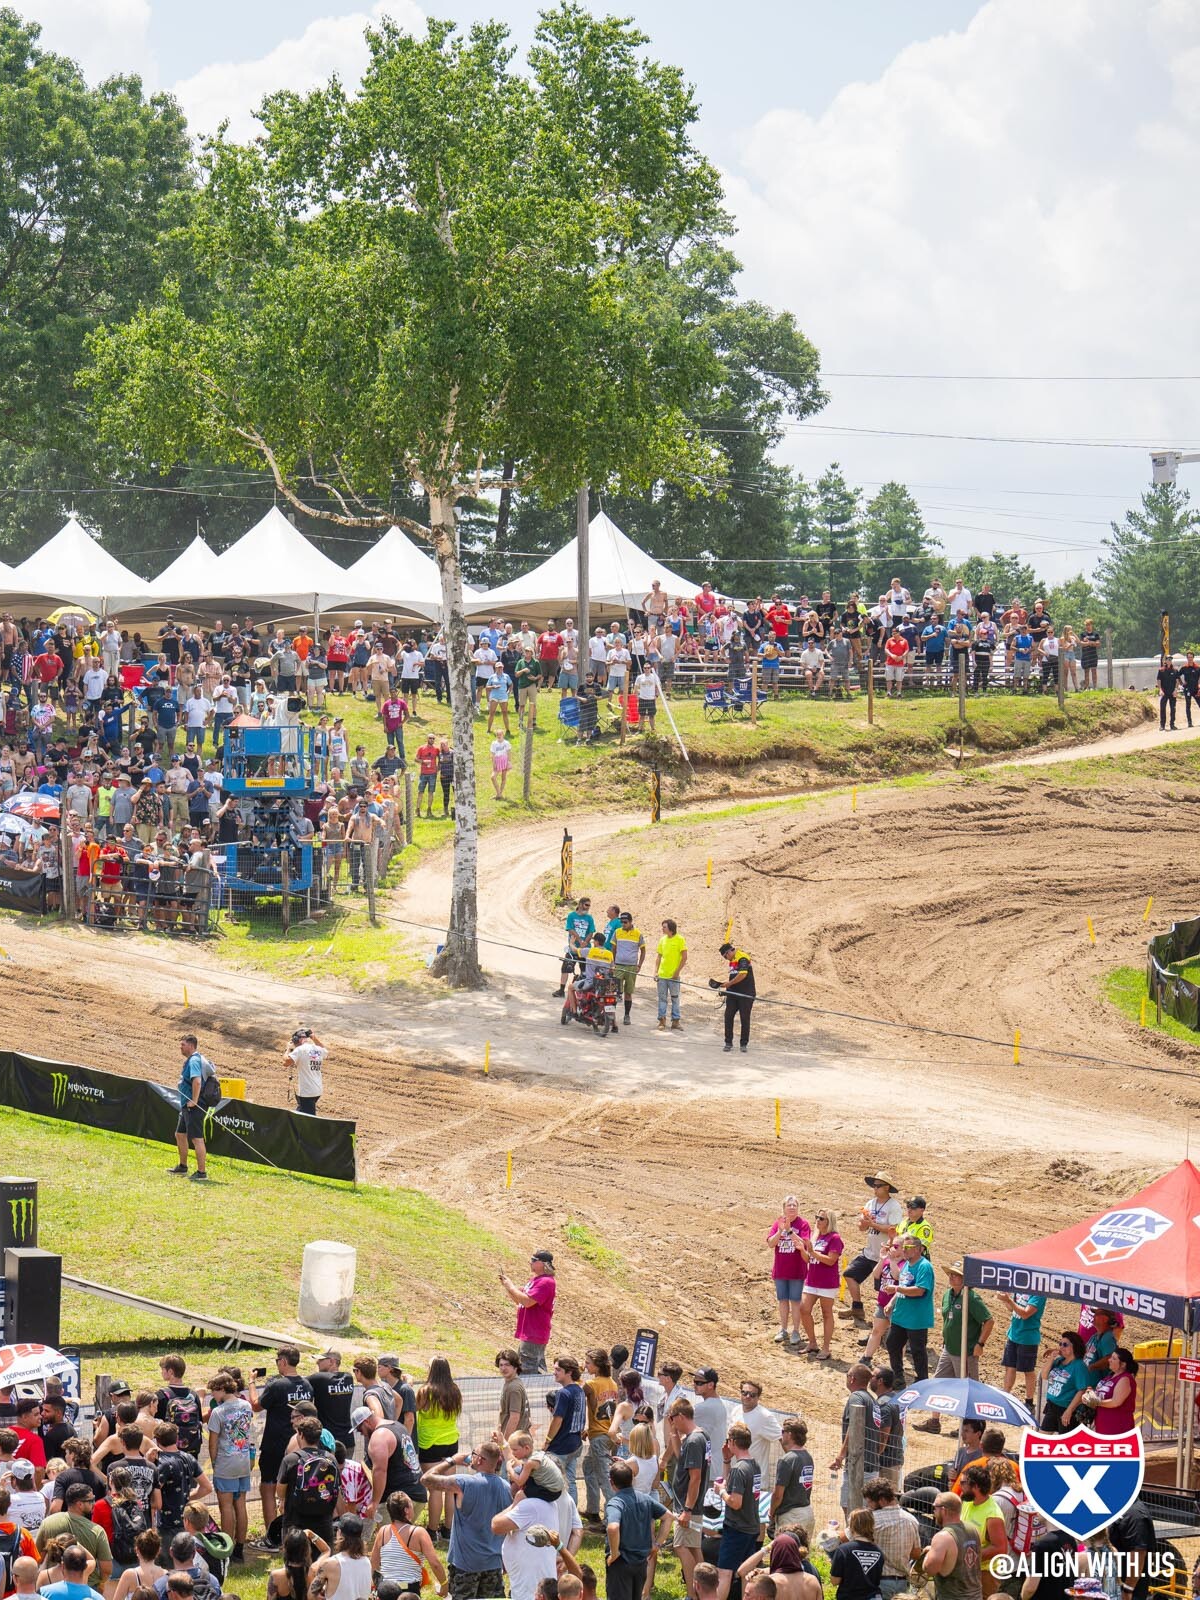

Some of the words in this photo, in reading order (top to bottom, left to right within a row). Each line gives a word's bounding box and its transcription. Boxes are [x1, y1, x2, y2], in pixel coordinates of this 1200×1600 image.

[67, 1082, 105, 1099] MONSTER
[215, 1115, 255, 1131] MONSTER
[1098, 1213, 1169, 1234] MX
[1111, 1232, 1140, 1243] RACING
[61, 1368, 79, 1399] 3
[328, 1384, 353, 1393] FILMS
[287, 1391, 311, 1401] FILMS
[979, 1405, 1002, 1417] 100%
